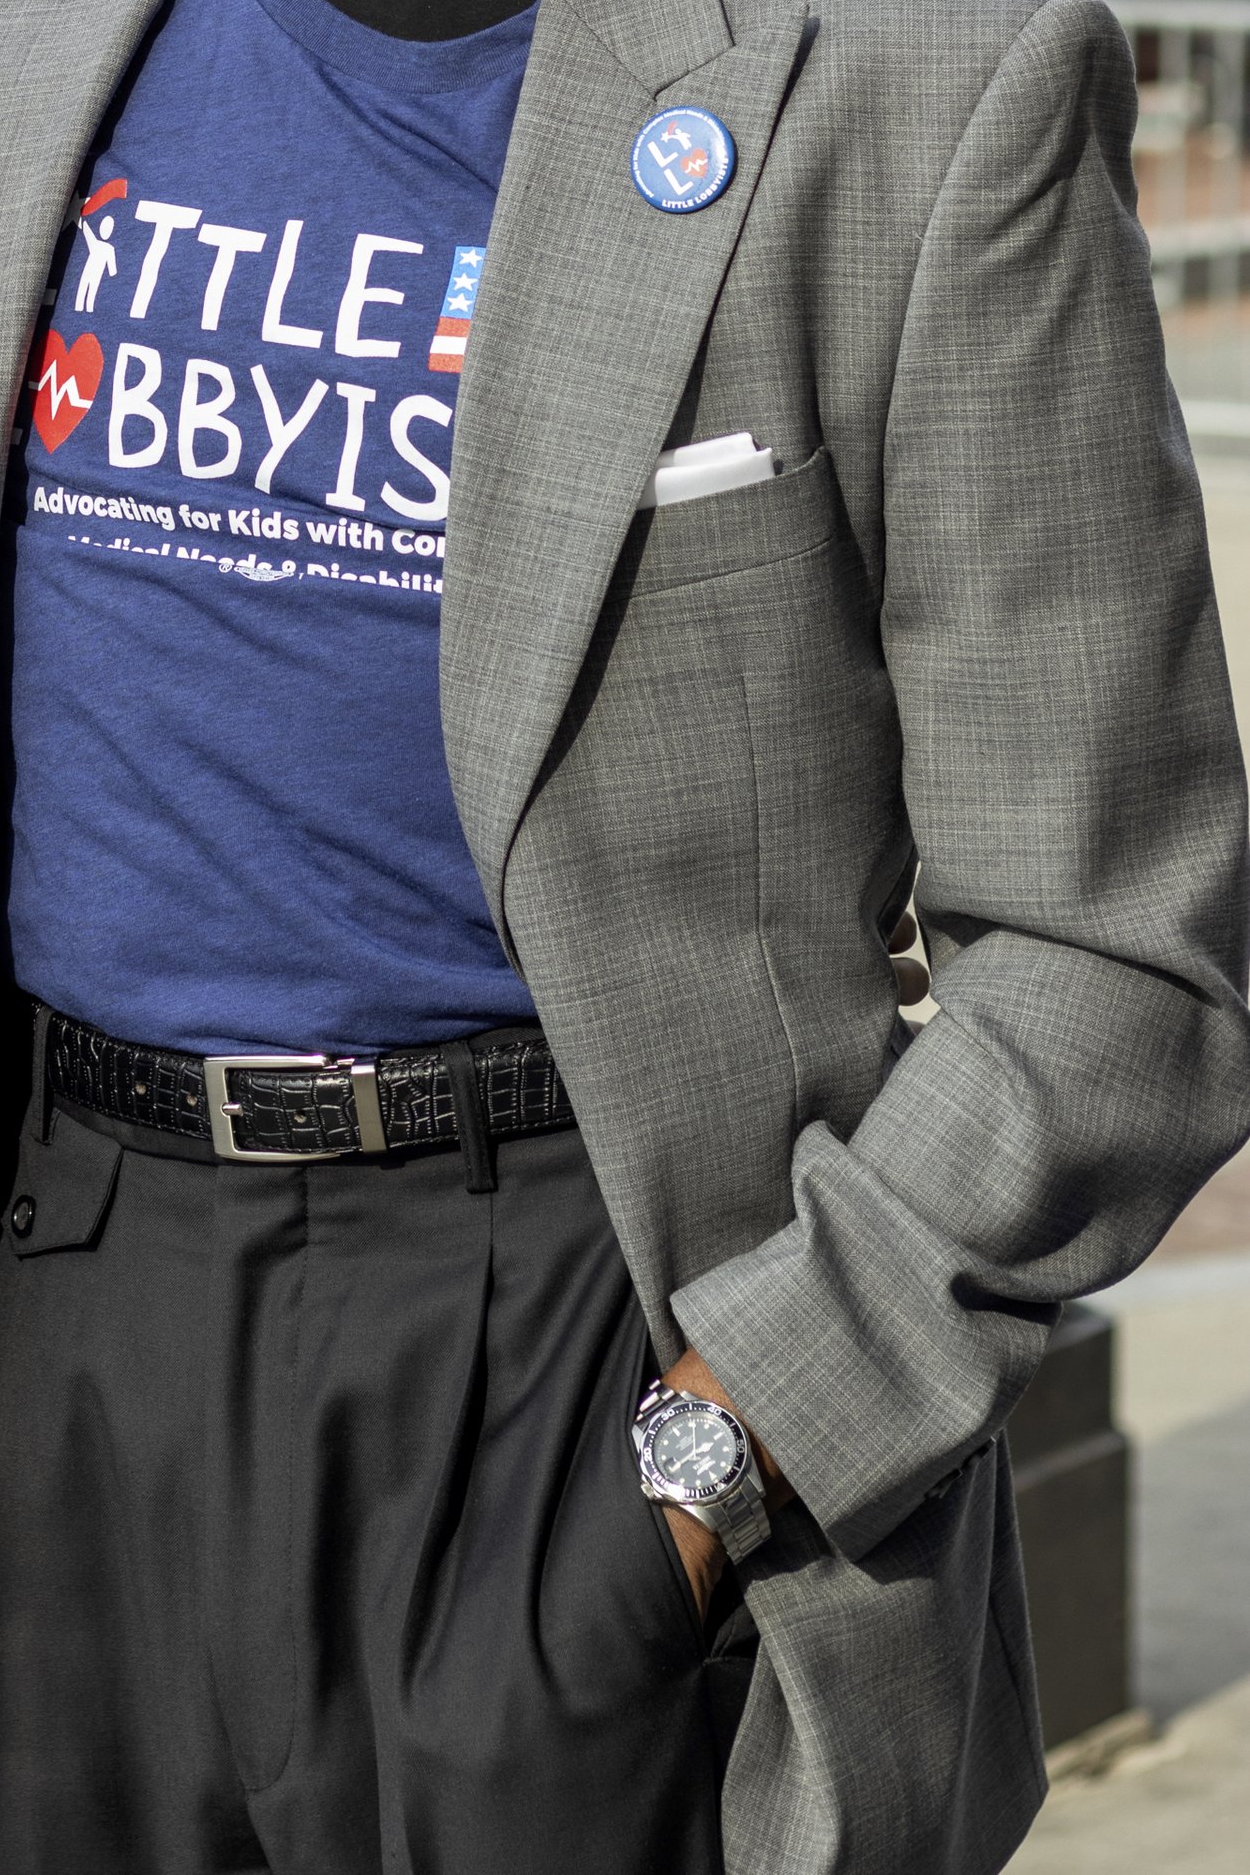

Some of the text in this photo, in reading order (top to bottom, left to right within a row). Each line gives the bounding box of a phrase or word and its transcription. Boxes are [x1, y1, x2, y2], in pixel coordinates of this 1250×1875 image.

[34, 487, 176, 531] Advocating
[179, 504, 222, 532] for
[228, 508, 300, 541] Kids
[306, 518, 384, 551] with
